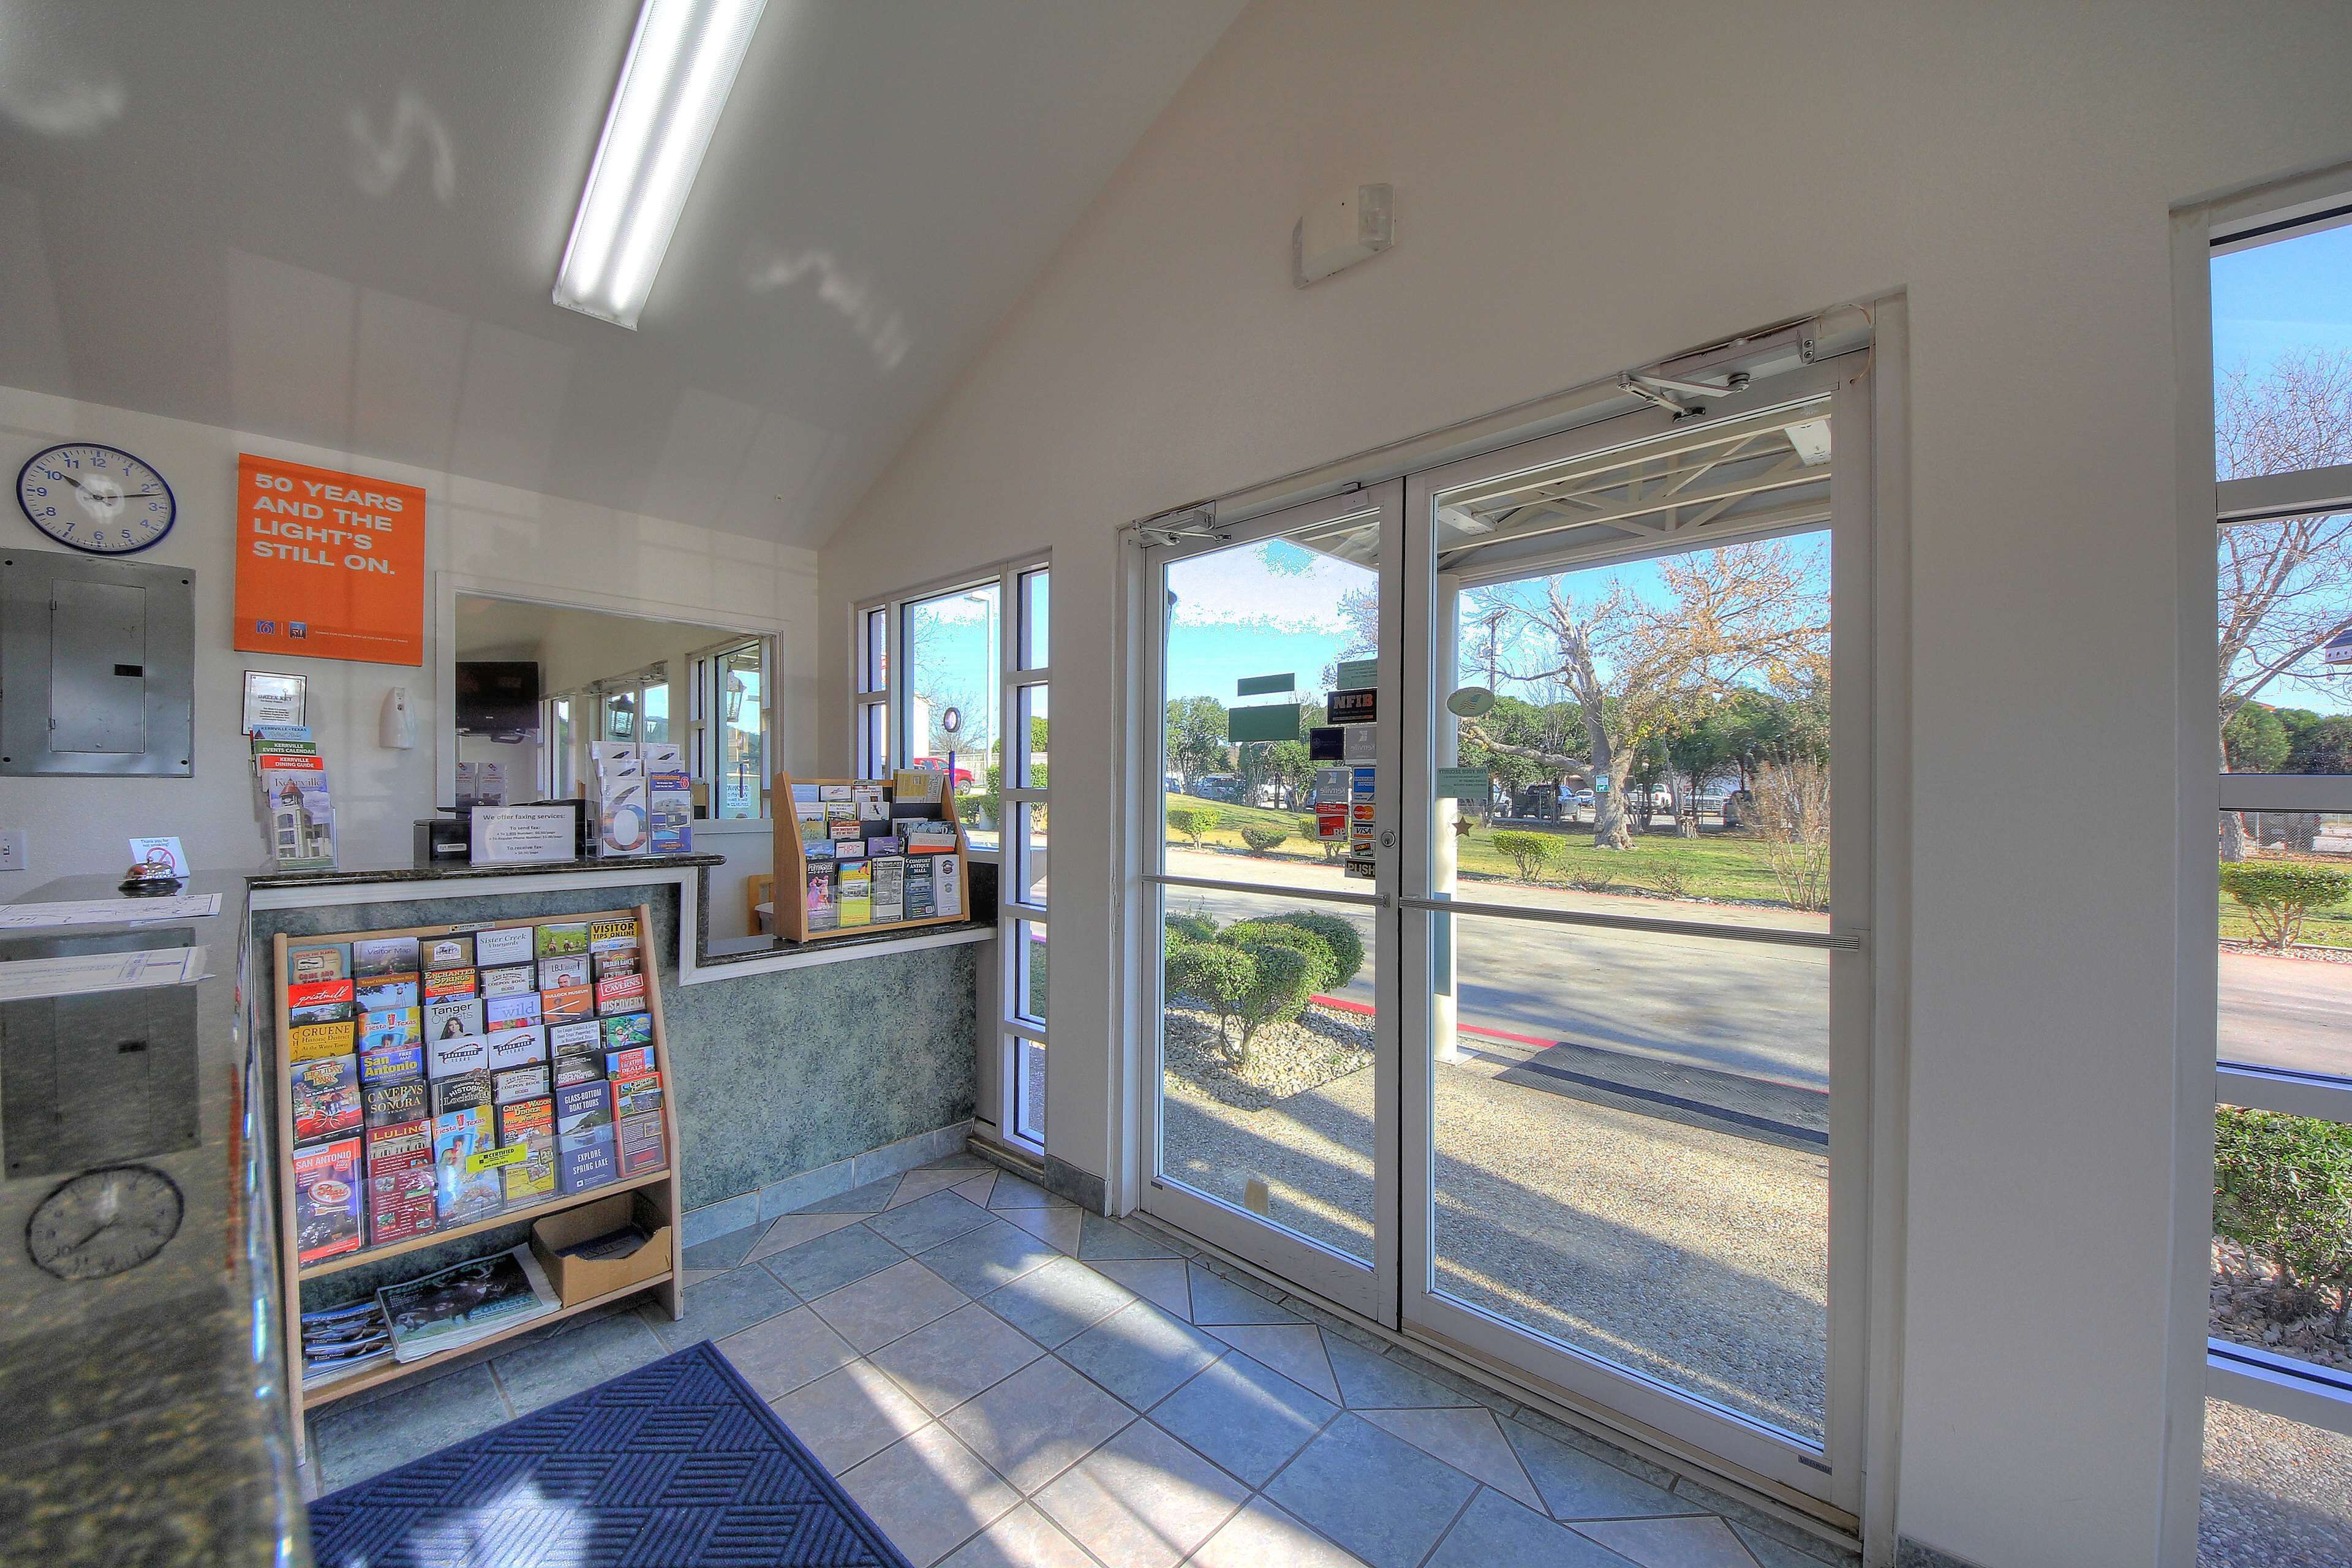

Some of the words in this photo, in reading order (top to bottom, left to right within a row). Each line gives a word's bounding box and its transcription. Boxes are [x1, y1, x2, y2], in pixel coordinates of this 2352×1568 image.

[64, 459, 79, 469] 11
[91, 457, 106, 468] 12
[45, 470, 62, 481] 10
[123, 468, 129, 477] 1
[37, 487, 48, 497] 9
[141, 484, 150, 492] 2
[255, 473, 293, 492] 50
[303, 480, 403, 512] YEARS
[45, 507, 56, 516] 8
[148, 502, 158, 511] 3
[253, 496, 323, 519] AND
[333, 508, 393, 532] THE
[66, 522, 75, 532] 7
[140, 519, 150, 528] 4
[94, 531, 104, 540] 6
[121, 529, 130, 538] 5
[254, 518, 372, 549] LIGHT'S
[252, 541, 334, 567] STILL
[344, 554, 395, 575] ON.
[260, 621, 273, 635] 6
[292, 628, 305, 636] 50
[1333, 694, 1373, 709] NFIB
[808, 863, 833, 872] PLAYHOUSE
[1348, 862, 1375, 875] PUSH
[593, 922, 635, 933] VISITOR
[552, 963, 563, 972] LBJ
[424, 968, 476, 980] ENCHANTED
[435, 974, 470, 984] SPRINGS
[605, 980, 641, 993] CAVERNS
[293, 985, 349, 1008] gristmill
[431, 1003, 472, 1015] Tanger
[502, 1001, 535, 1017] wild
[600, 997, 644, 1011] DISCOVERY
[432, 1011, 473, 1024] Outlets
[303, 1025, 350, 1037] GRUENE
[364, 1056, 390, 1068] San
[622, 1058, 642, 1068] VACATION
[305, 1065, 344, 1079] HOLIDAY
[364, 1061, 417, 1077] Antonio
[622, 1065, 643, 1073] DEALS
[314, 1075, 337, 1085] PARK
[368, 1085, 423, 1103] CAVERNS
[449, 1085, 485, 1097] HISTORIC
[565, 1088, 601, 1104] GLASS-BOTTOM
[371, 1096, 421, 1114] SONORA
[503, 1104, 526, 1112] CHUCK
[527, 1099, 552, 1107] WAGON
[569, 1102, 582, 1112] BOAT
[582, 1098, 599, 1108] TOURS
[515, 1107, 541, 1116] DINNER
[374, 1125, 427, 1141] LULING
[436, 1126, 456, 1135] Fiesta
[489, 1148, 514, 1158] CERTIFIED
[578, 1148, 601, 1163] EXPLORE
[296, 1159, 313, 1170] SAN
[315, 1150, 352, 1165] ANTONIO
[573, 1163, 594, 1175] SPRING
[595, 1158, 608, 1169] LAKE
